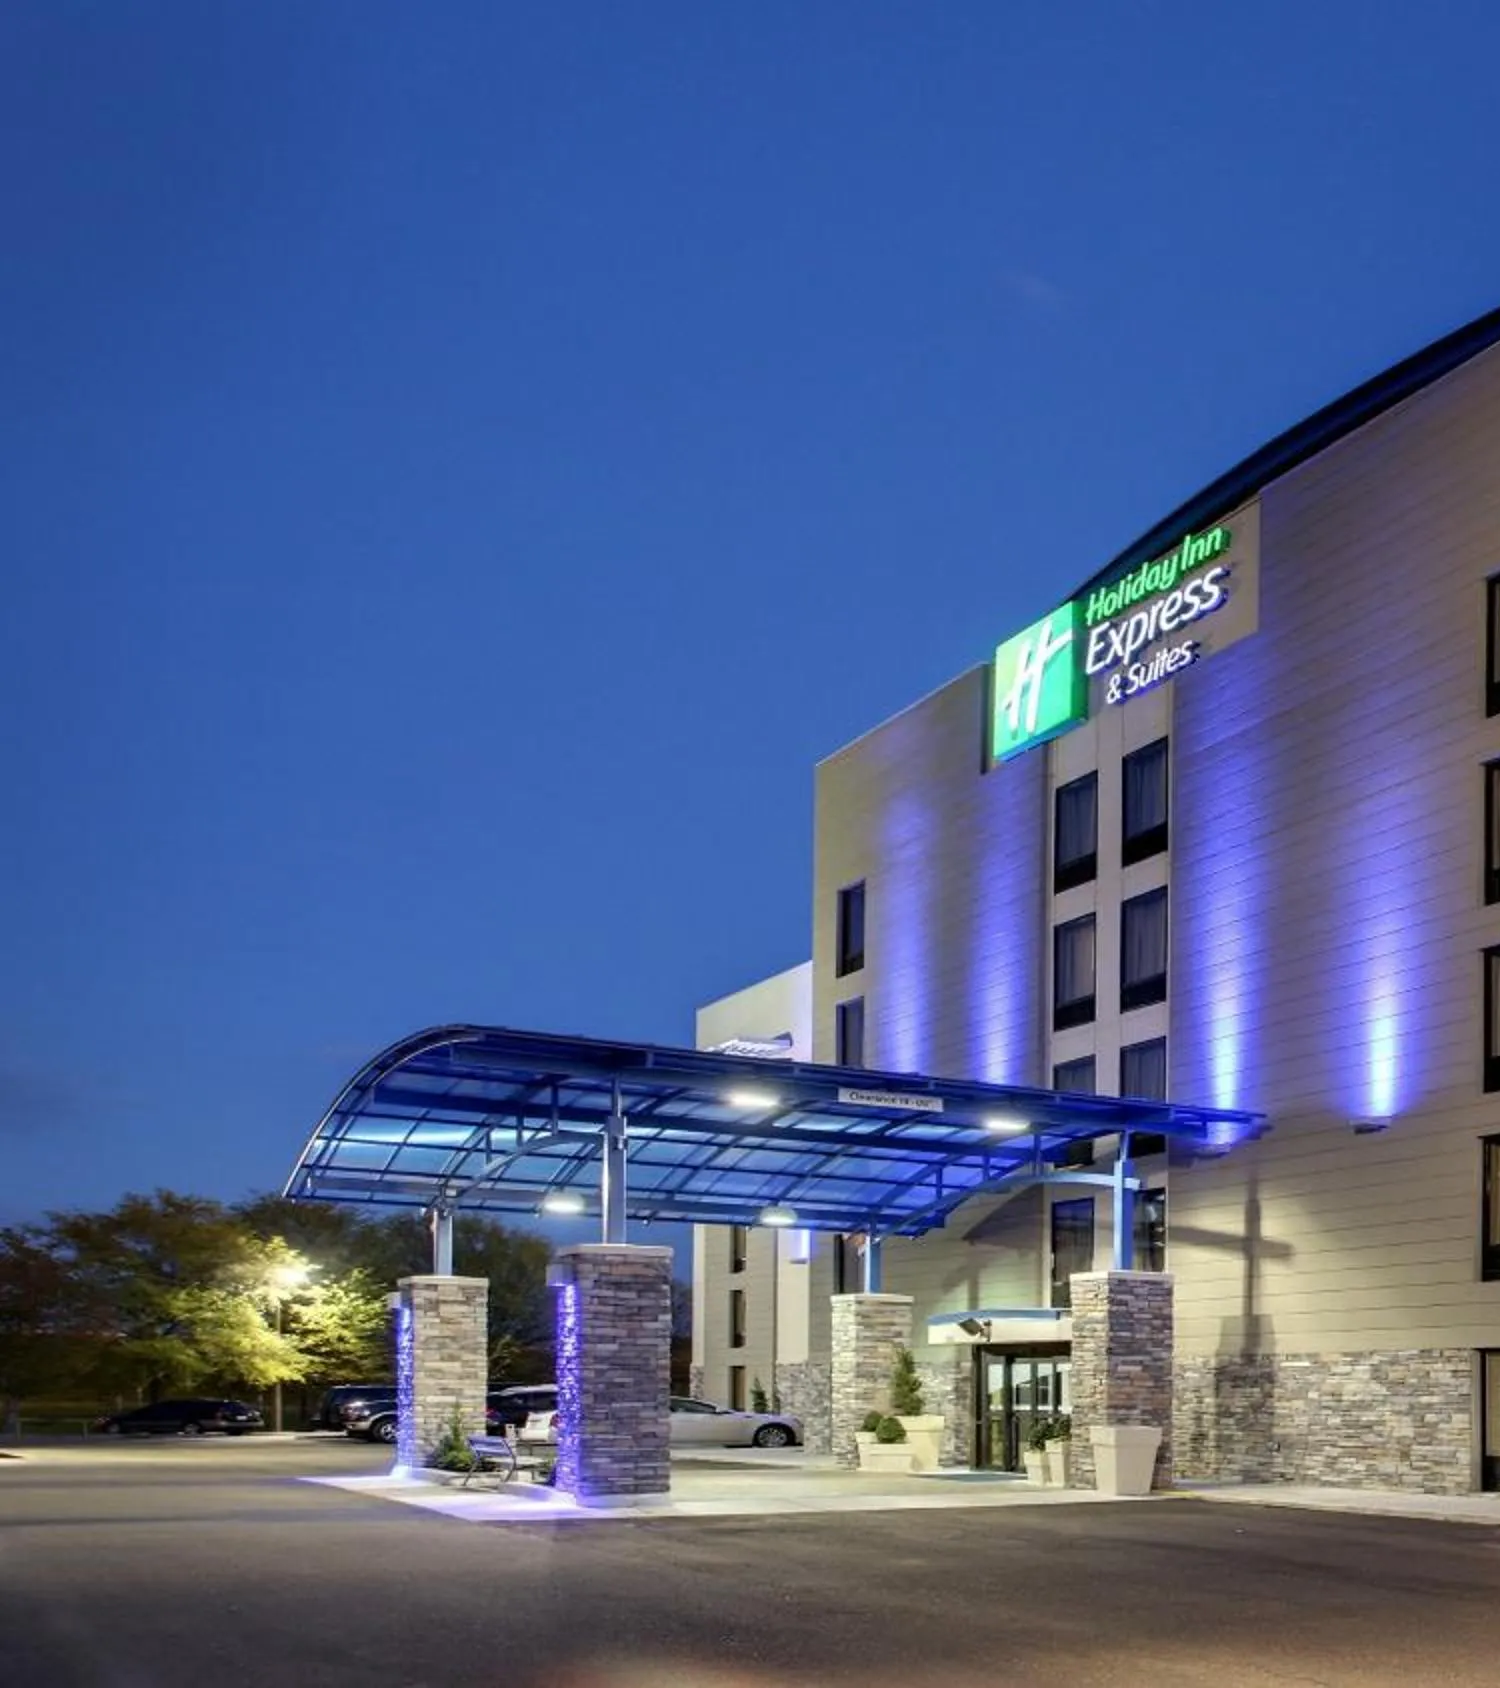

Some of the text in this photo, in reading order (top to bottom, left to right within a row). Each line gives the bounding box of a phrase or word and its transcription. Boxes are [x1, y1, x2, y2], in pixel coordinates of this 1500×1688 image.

[1085, 528, 1223, 626] Holiday Inn
[1085, 566, 1223, 675] Express
[1105, 640, 1193, 705] & Suites
